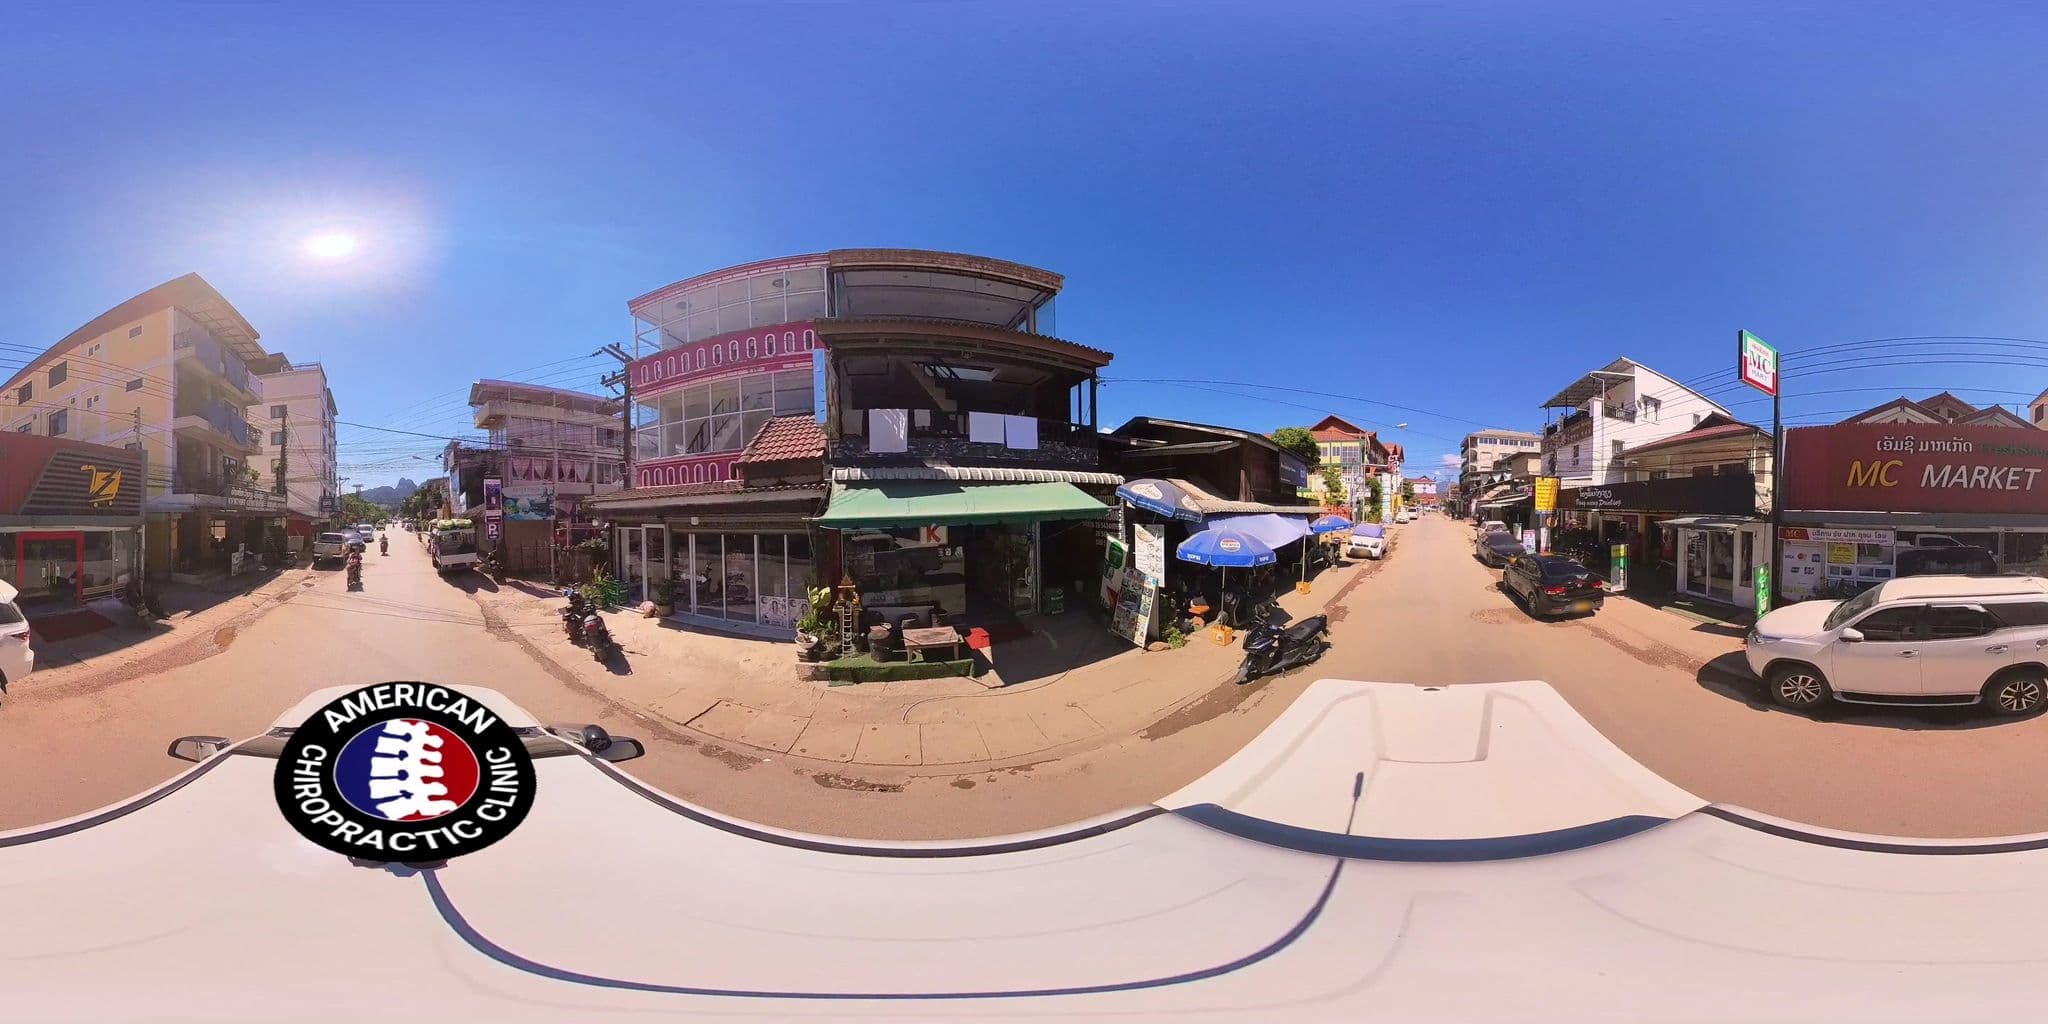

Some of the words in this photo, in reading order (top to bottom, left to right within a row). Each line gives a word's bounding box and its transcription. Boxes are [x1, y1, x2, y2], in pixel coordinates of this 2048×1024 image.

[1749, 351, 1771, 374] MC
[1847, 460, 1904, 488] MC
[1920, 464, 2042, 491] MARKET
